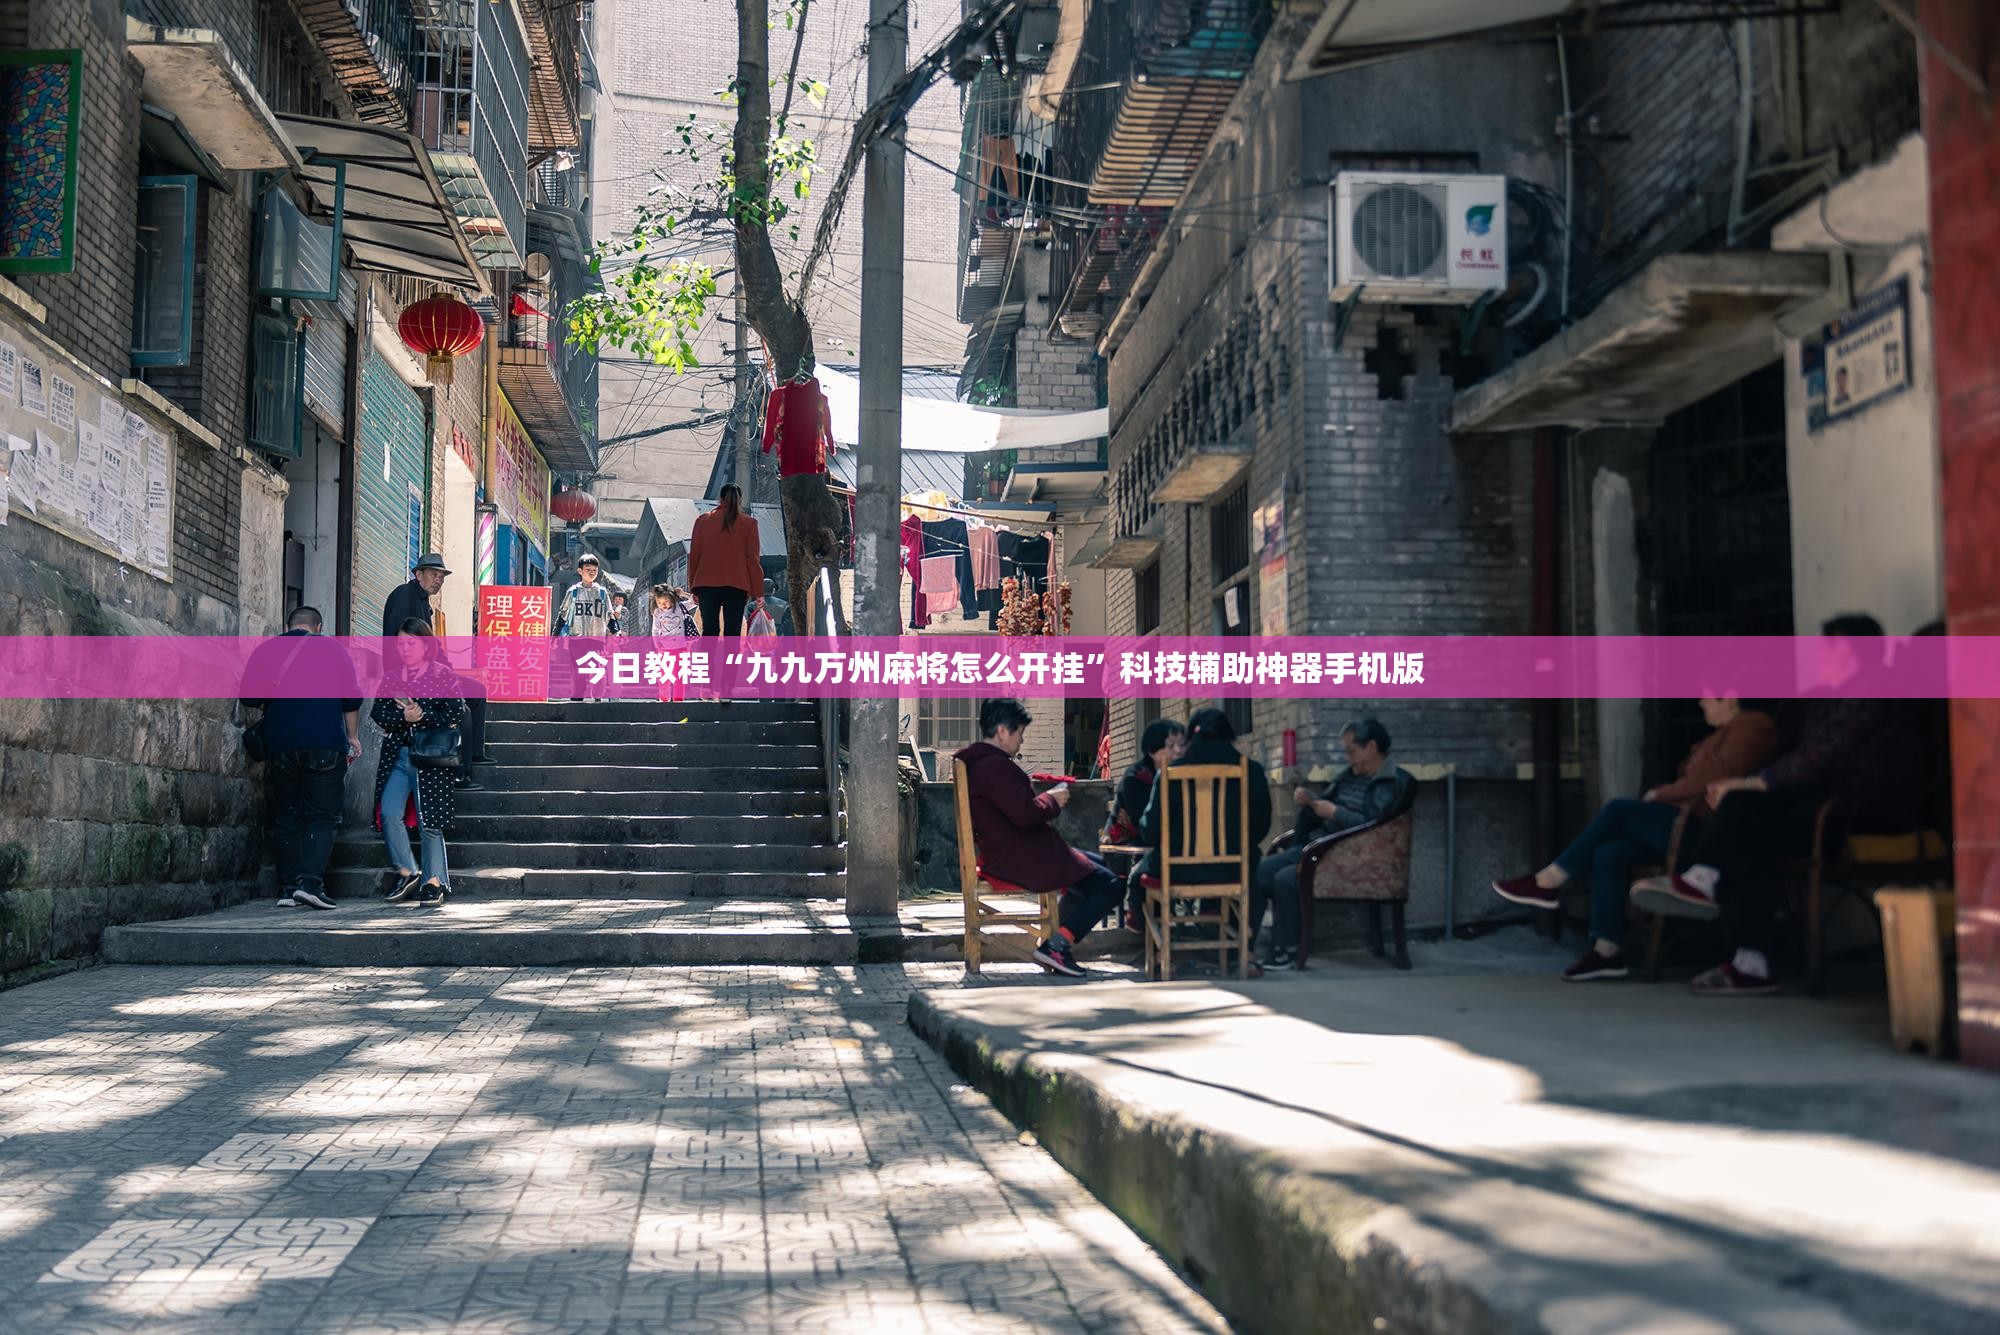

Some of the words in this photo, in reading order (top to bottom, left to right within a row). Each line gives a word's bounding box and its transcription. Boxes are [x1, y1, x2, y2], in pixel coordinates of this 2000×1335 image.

[486, 595, 546, 619] 理发
[485, 619, 546, 645] 保健
[484, 646, 544, 671] 盘发
